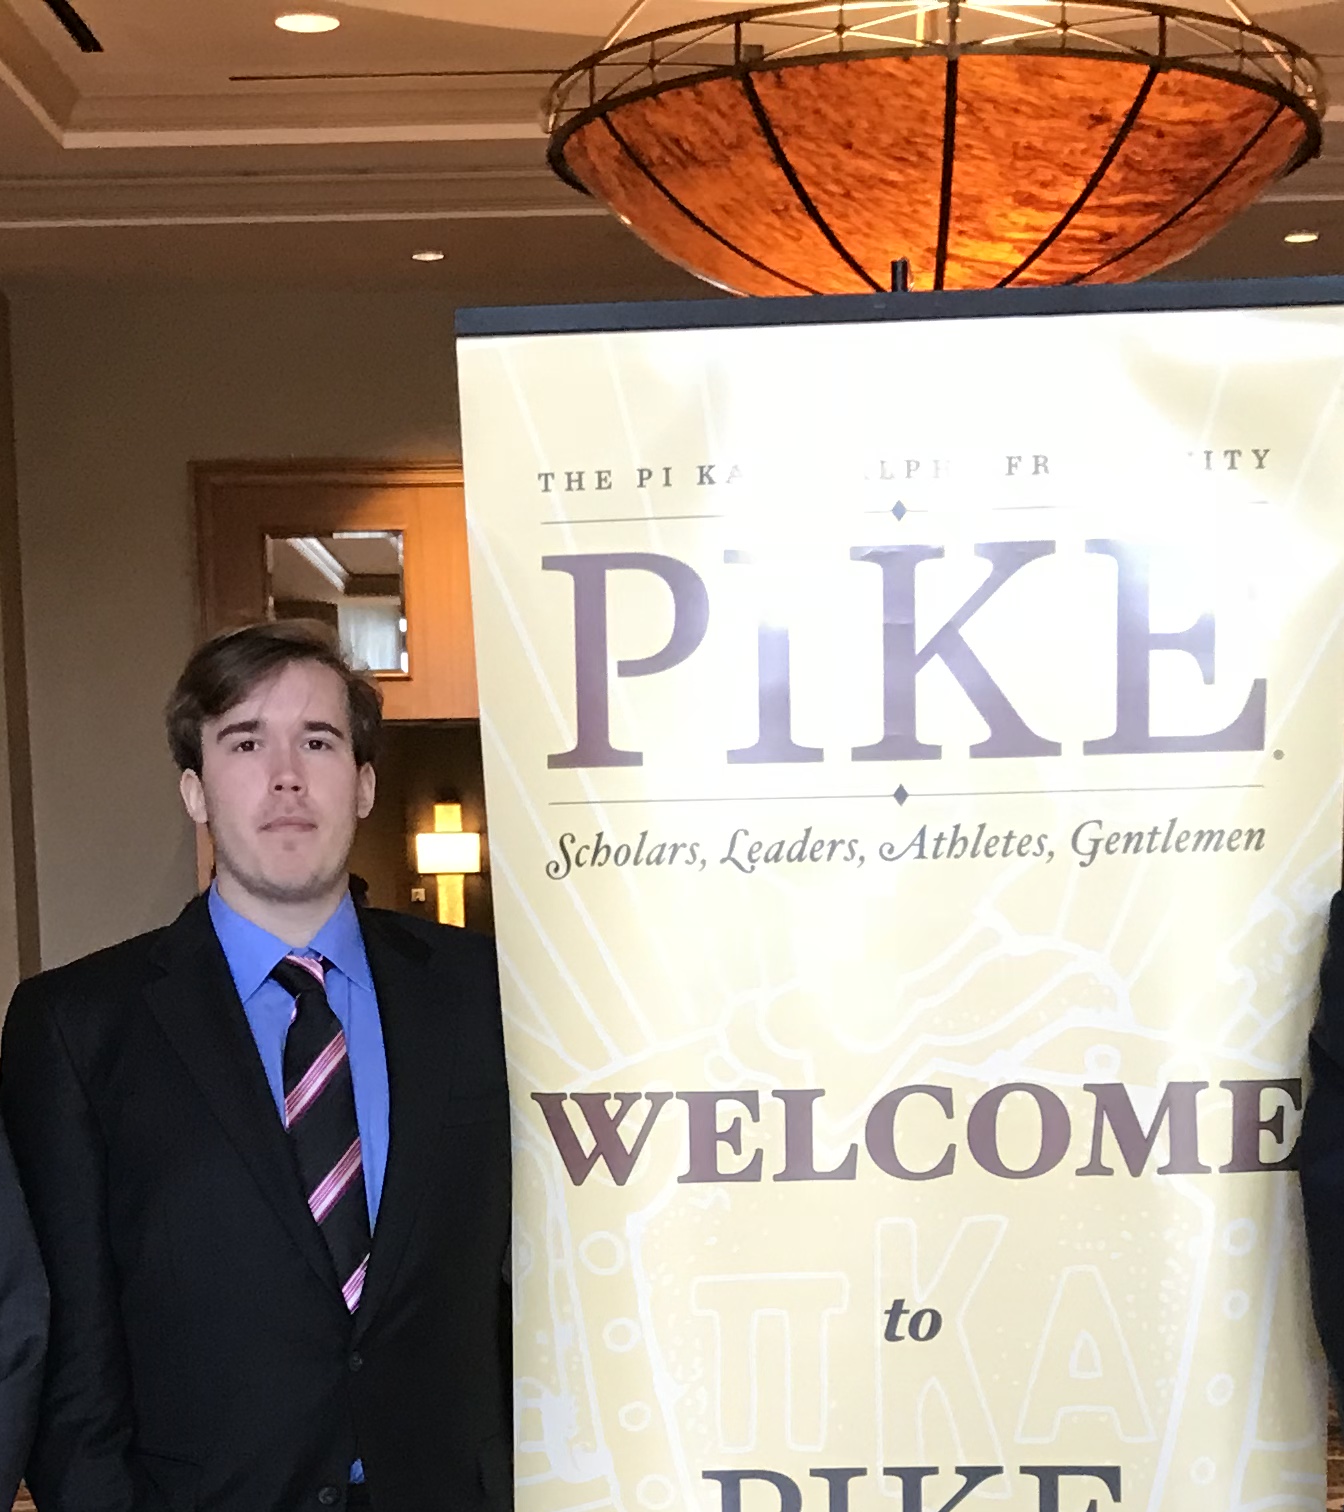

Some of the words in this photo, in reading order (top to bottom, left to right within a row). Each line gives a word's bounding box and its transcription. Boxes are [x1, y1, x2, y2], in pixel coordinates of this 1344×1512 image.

[537, 469, 613, 493] THE
[636, 466, 673, 489] PI
[544, 829, 707, 881] Scholars,
[719, 826, 866, 876] Leaders,
[879, 821, 1056, 865] Athletes,
[1070, 816, 1267, 868] Gentlemen
[530, 1076, 1303, 1188] WELCOME
[883, 1297, 944, 1343] to
